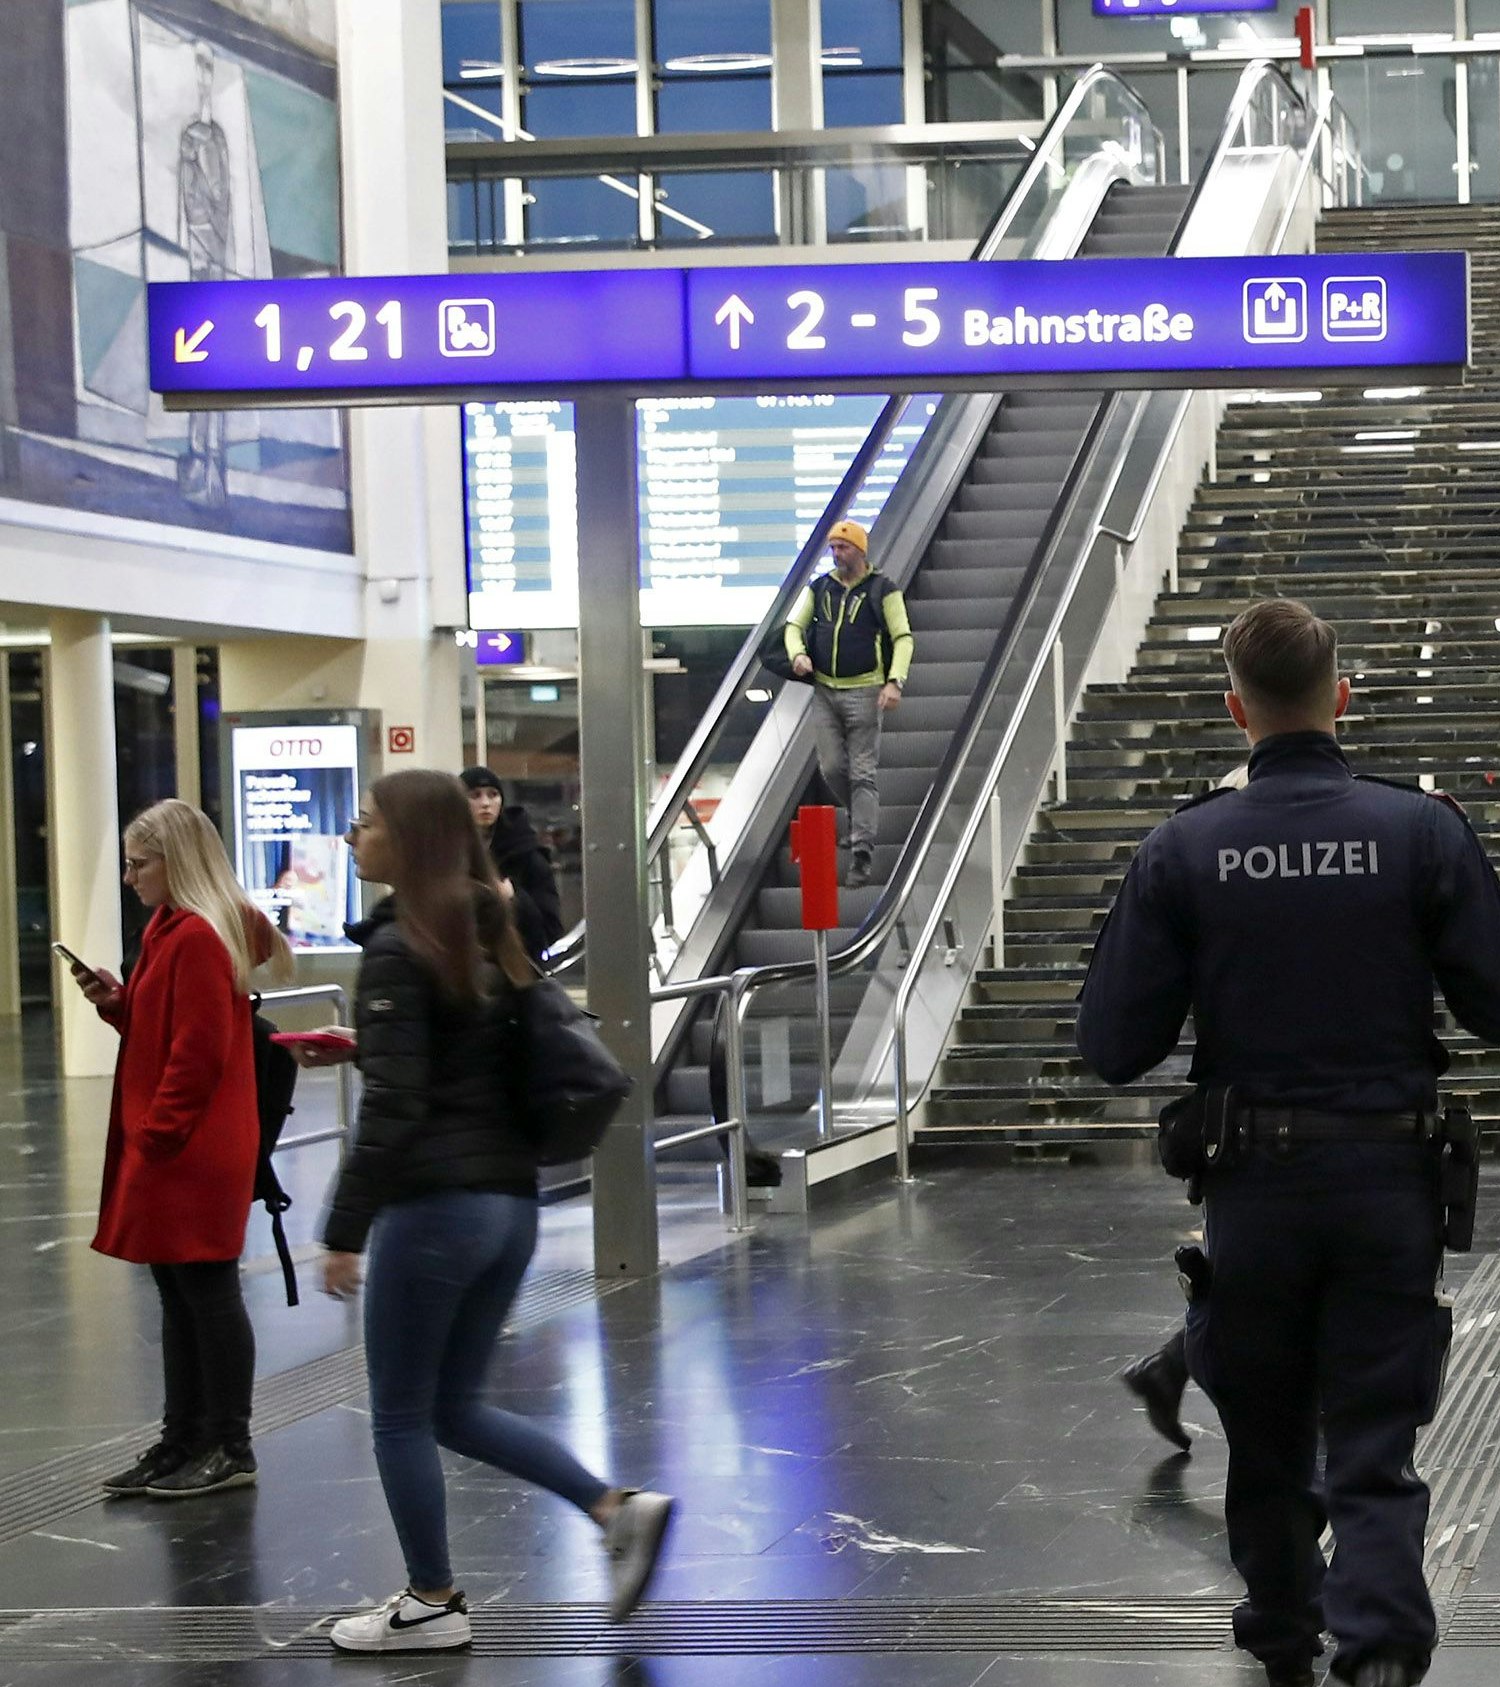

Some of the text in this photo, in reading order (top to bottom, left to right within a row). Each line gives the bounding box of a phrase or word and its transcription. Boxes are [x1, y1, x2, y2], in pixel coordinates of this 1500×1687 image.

[786, 290, 827, 350] 2
[902, 287, 941, 347] 5
[963, 303, 1194, 346] Bahnstraße
[1330, 292, 1381, 320] P+R
[254, 300, 403, 371] 1,21
[269, 738, 322, 756] OTTO
[1218, 840, 1379, 882] POLIZEI
